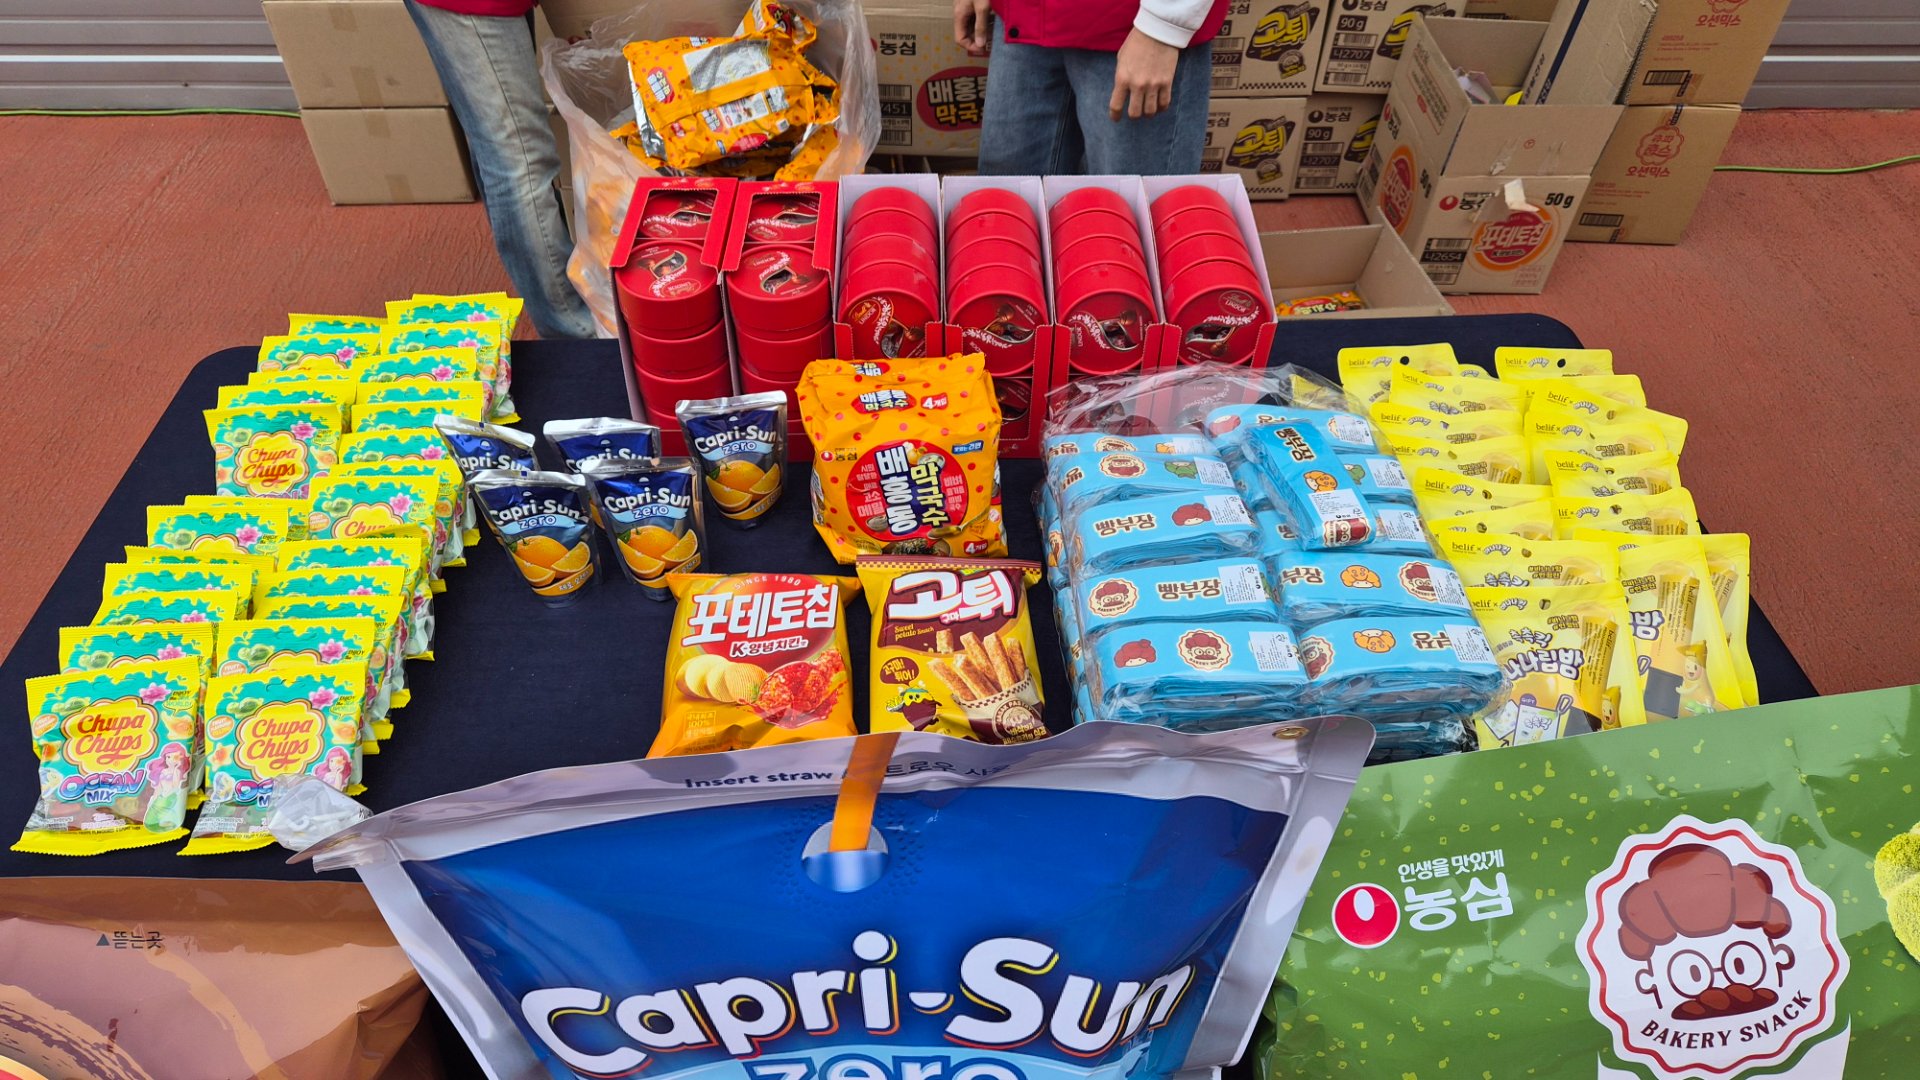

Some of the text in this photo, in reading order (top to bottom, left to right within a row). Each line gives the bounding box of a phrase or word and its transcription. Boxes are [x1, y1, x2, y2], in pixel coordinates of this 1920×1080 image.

[1359, 0, 1387, 11] 농심
[1252, 11, 1309, 46] 고튀
[1341, 18, 1364, 30] 90 g
[1695, 14, 1741, 27] 오션믹스
[880, 41, 916, 56] 농심
[1332, 50, 1371, 60] 나2707
[935, 103, 983, 124] 막국
[1324, 112, 1351, 123] 농심
[1231, 125, 1286, 155] 고튀
[1308, 129, 1331, 139] 90 g
[1625, 166, 1671, 178] 오션믹스
[1544, 192, 1575, 209] 50 g
[1475, 222, 1550, 251] 포테토칩
[859, 389, 908, 403] 배홍동
[1548, 391, 1570, 403] belif
[1380, 413, 1402, 422] belif
[1535, 422, 1556, 432] belif
[694, 425, 778, 453] Capri-Sun
[722, 440, 758, 455] zero
[1274, 427, 1316, 463] 빵부장
[247, 447, 298, 464] Chupa
[1555, 460, 1575, 469] belif
[242, 461, 297, 487] Chups
[875, 445, 919, 535] 배홍동
[910, 460, 949, 527] 막국수
[1425, 479, 1446, 490] belif
[604, 487, 691, 513] Capri-Sun
[489, 498, 581, 526] Capri-Sun
[632, 504, 669, 519] zero
[518, 514, 557, 530] zero
[1095, 514, 1155, 536] 빵부장
[1452, 541, 1475, 552] belif
[734, 575, 802, 591] SINCE 1980
[1282, 567, 1324, 584] 부장
[888, 570, 1014, 619] 고튀
[1158, 580, 1222, 599] 빵부장
[1687, 585, 1696, 606] belif
[682, 583, 840, 647] 포테토칩
[894, 624, 914, 634] Sweet
[895, 627, 935, 642] potato Snack
[1606, 629, 1615, 650] belif
[77, 713, 146, 734] Chupa
[251, 717, 314, 738] Chupa
[75, 732, 142, 765] Chups
[246, 736, 310, 770] Chups
[60, 769, 145, 800] OCEAN
[685, 775, 759, 788] Insert
[767, 772, 832, 784] straw
[86, 790, 114, 803] MIX
[1398, 848, 1505, 883] 인생을 맛있게
[1404, 872, 1514, 932] 농심
[112, 931, 163, 950] 뜯는곳
[521, 930, 1196, 1076] Capri-Sun
[1640, 989, 1814, 1050] BAKERY SNACK
